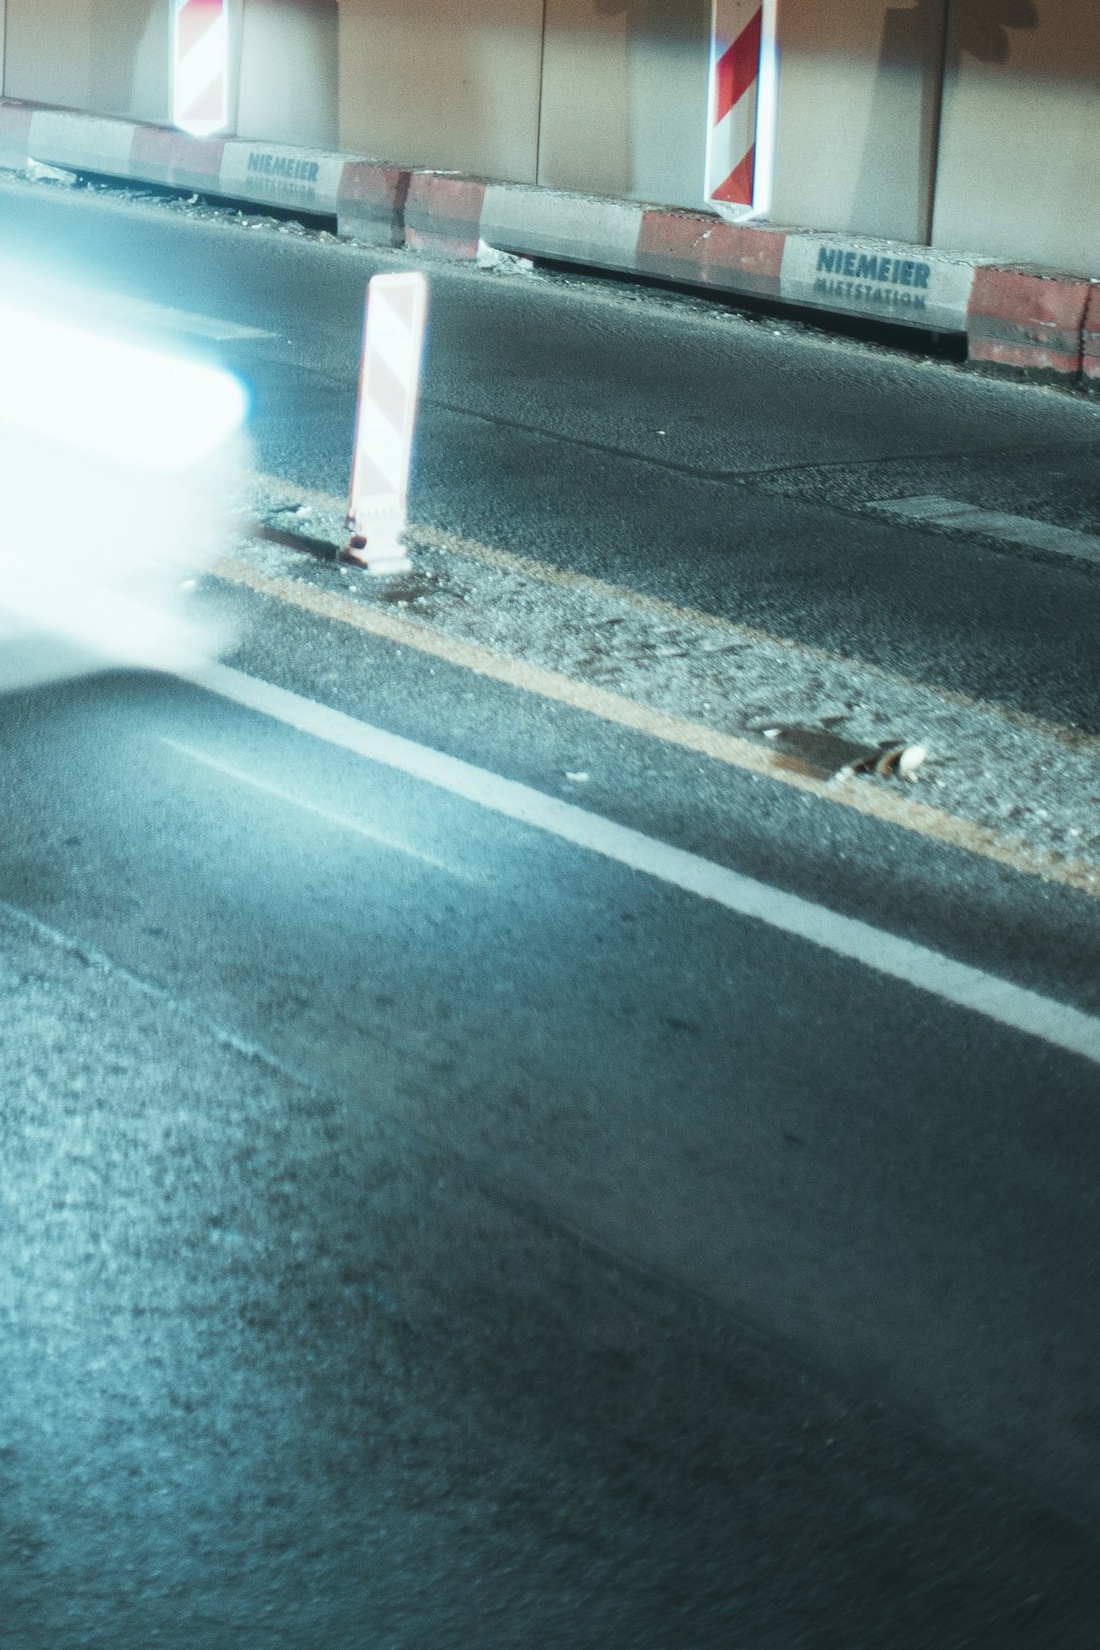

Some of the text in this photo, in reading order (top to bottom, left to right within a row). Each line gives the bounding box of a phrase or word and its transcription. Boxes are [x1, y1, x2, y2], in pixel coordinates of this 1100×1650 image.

[247, 152, 320, 183] NIEMEIER
[816, 246, 931, 289] NIEMEIER
[813, 278, 927, 310] MIETSTATION
